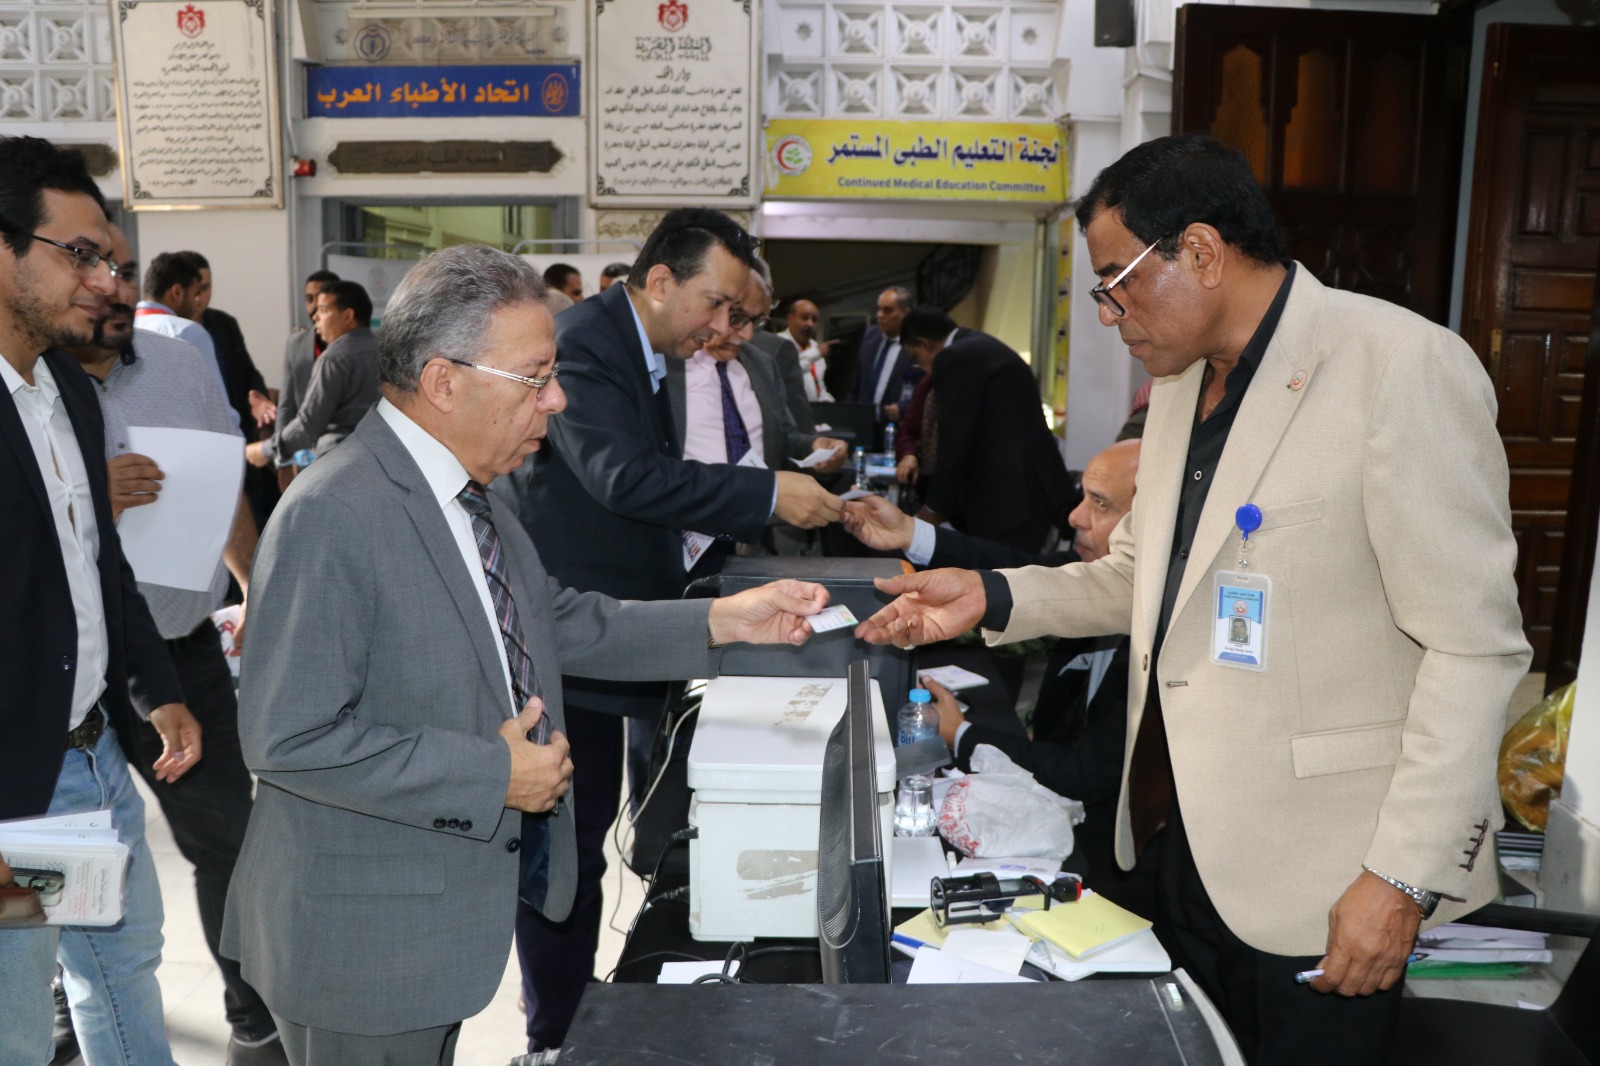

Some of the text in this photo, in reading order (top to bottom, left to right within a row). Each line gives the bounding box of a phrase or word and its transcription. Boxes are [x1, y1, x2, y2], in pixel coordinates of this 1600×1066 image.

[316, 81, 381, 109] العرب
[388, 77, 467, 109] الأطباء
[474, 80, 529, 104] اتحاد
[826, 134, 889, 164] المستمر
[952, 138, 1015, 170] التعليم
[1018, 136, 1059, 171] لجنة
[838, 176, 1047, 193] Continued Medical Education Committee
